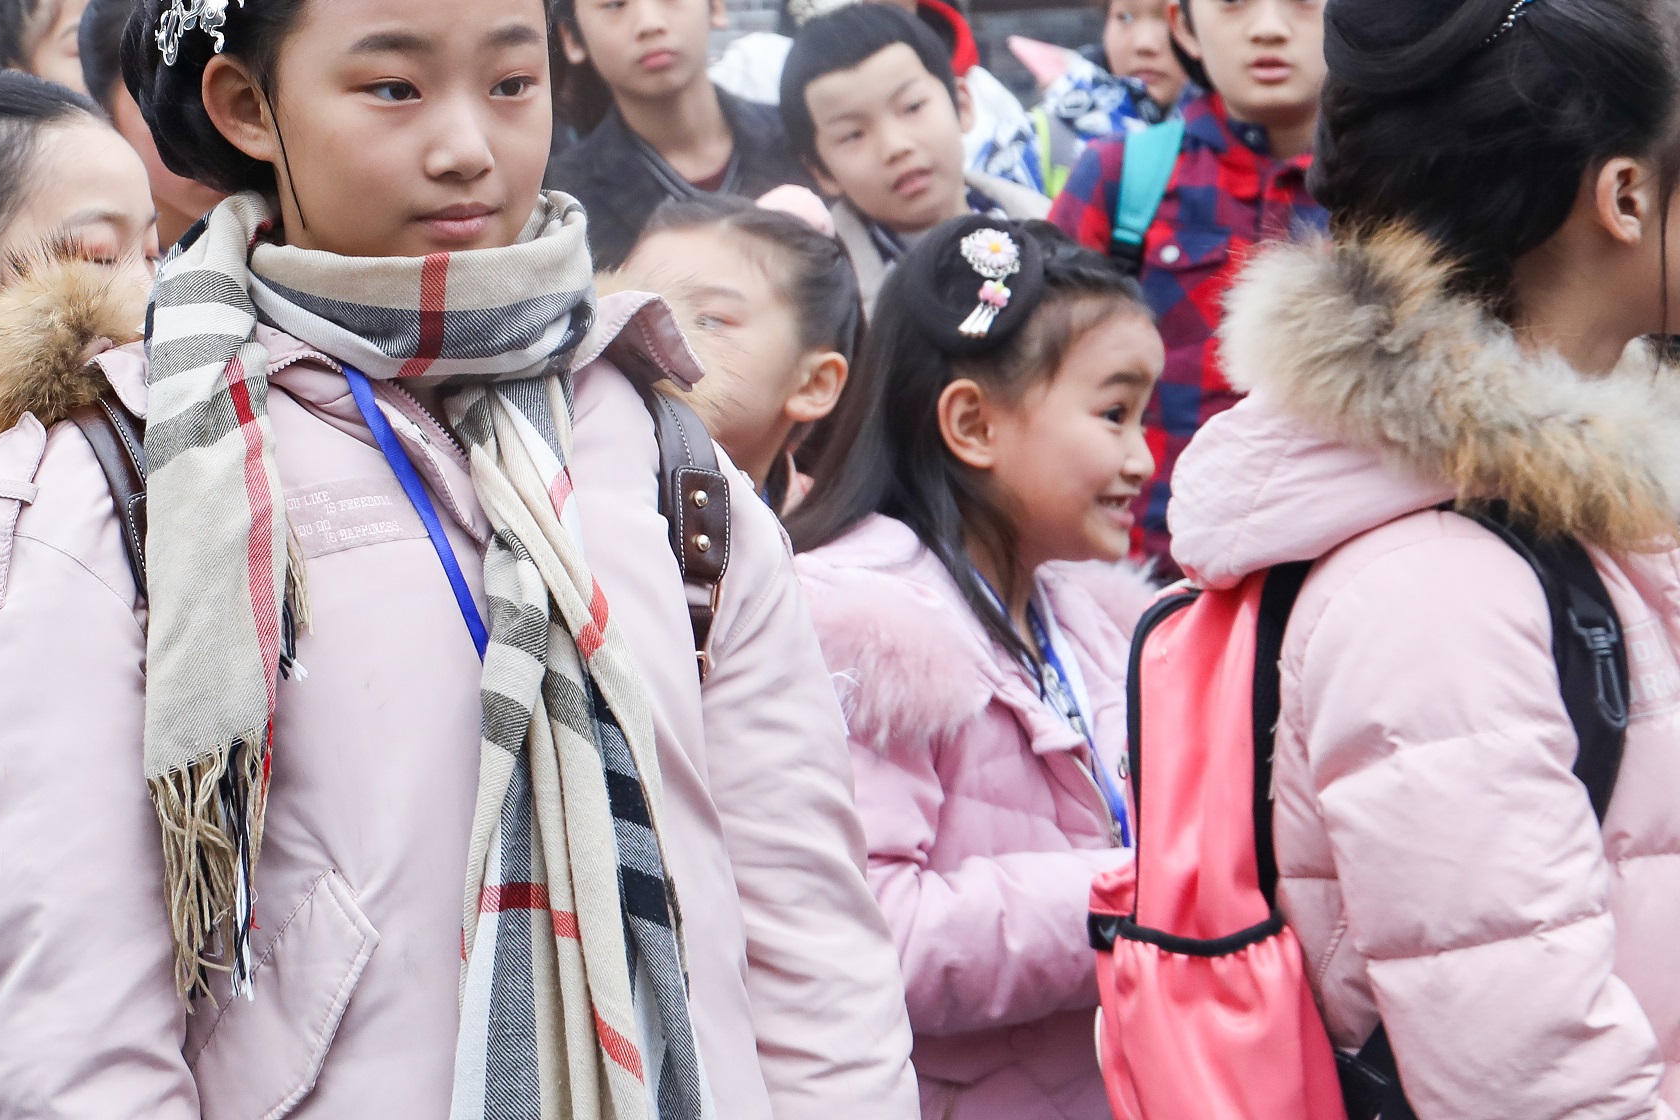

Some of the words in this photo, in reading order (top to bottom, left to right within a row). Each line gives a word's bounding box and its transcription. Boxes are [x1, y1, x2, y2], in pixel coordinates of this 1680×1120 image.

[286, 498, 300, 510] OU
[304, 491, 330, 505] LIKE
[326, 502, 337, 514] IS
[315, 520, 331, 532] DO
[326, 532, 337, 544] IS
